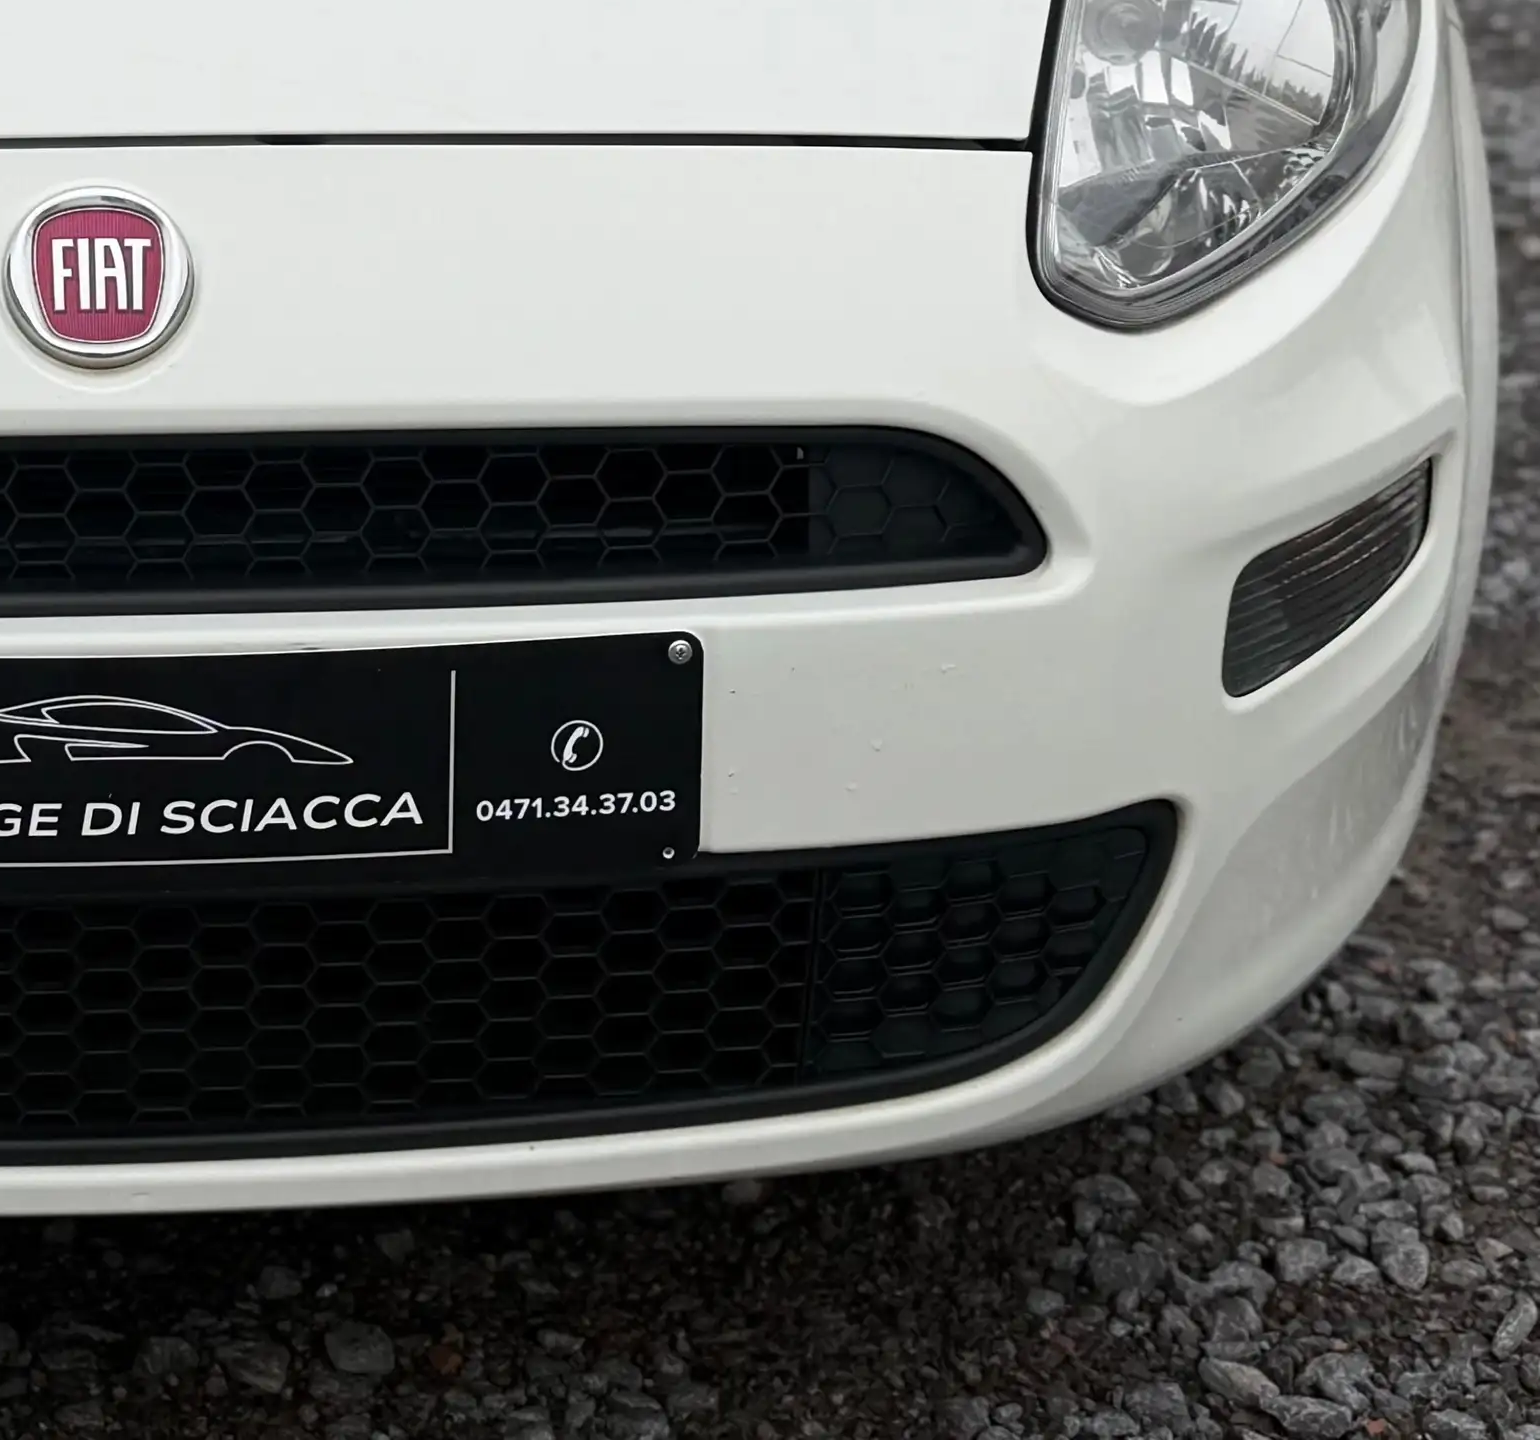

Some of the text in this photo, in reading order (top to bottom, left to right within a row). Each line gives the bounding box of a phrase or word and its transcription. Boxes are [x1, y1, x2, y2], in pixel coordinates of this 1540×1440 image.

[51, 237, 152, 311] FIAT
[80, 801, 141, 835] DI
[160, 791, 424, 835] SCIACCA
[475, 789, 677, 822] 0471.34.37.03
